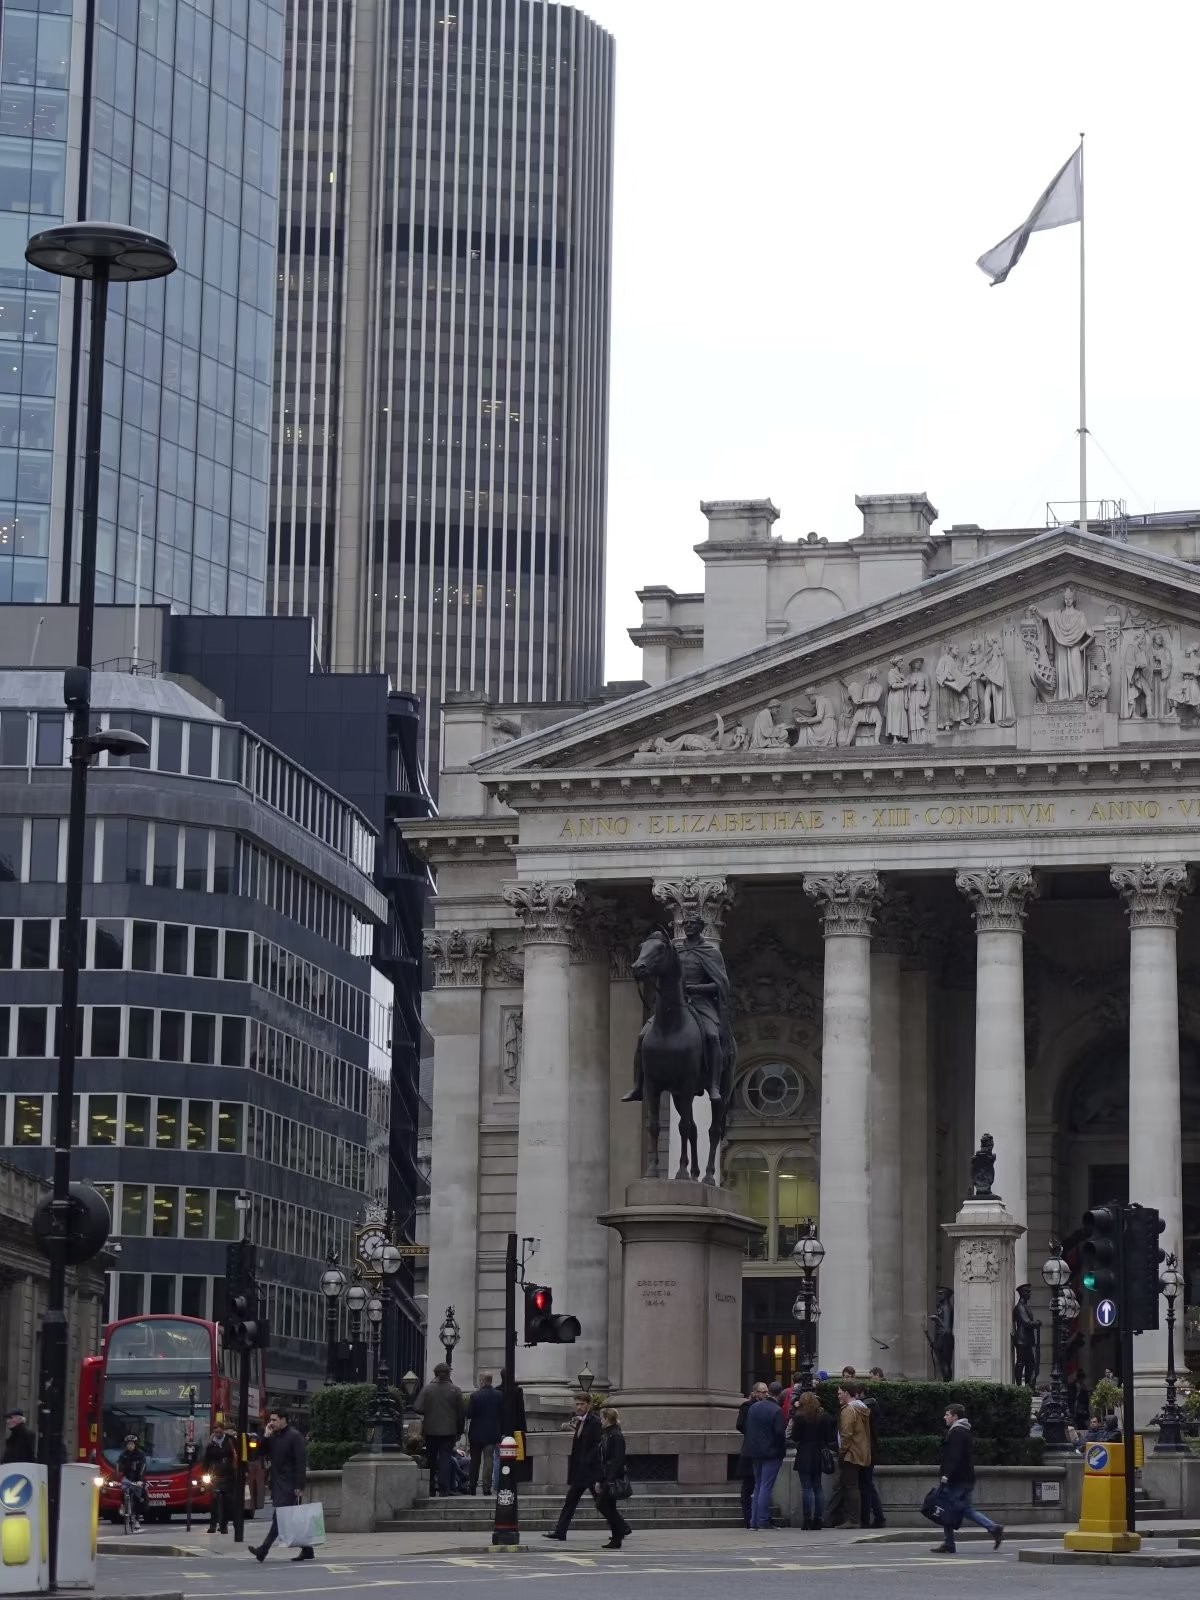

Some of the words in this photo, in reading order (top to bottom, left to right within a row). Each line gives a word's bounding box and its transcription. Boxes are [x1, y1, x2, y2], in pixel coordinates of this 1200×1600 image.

[560, 816, 631, 838] ANNO
[647, 810, 826, 835] ELIZABETHAE
[842, 808, 858, 829] R
[872, 807, 912, 829] XIII
[924, 803, 1055, 826] CONDITVM
[1088, 799, 1161, 821] ANNO
